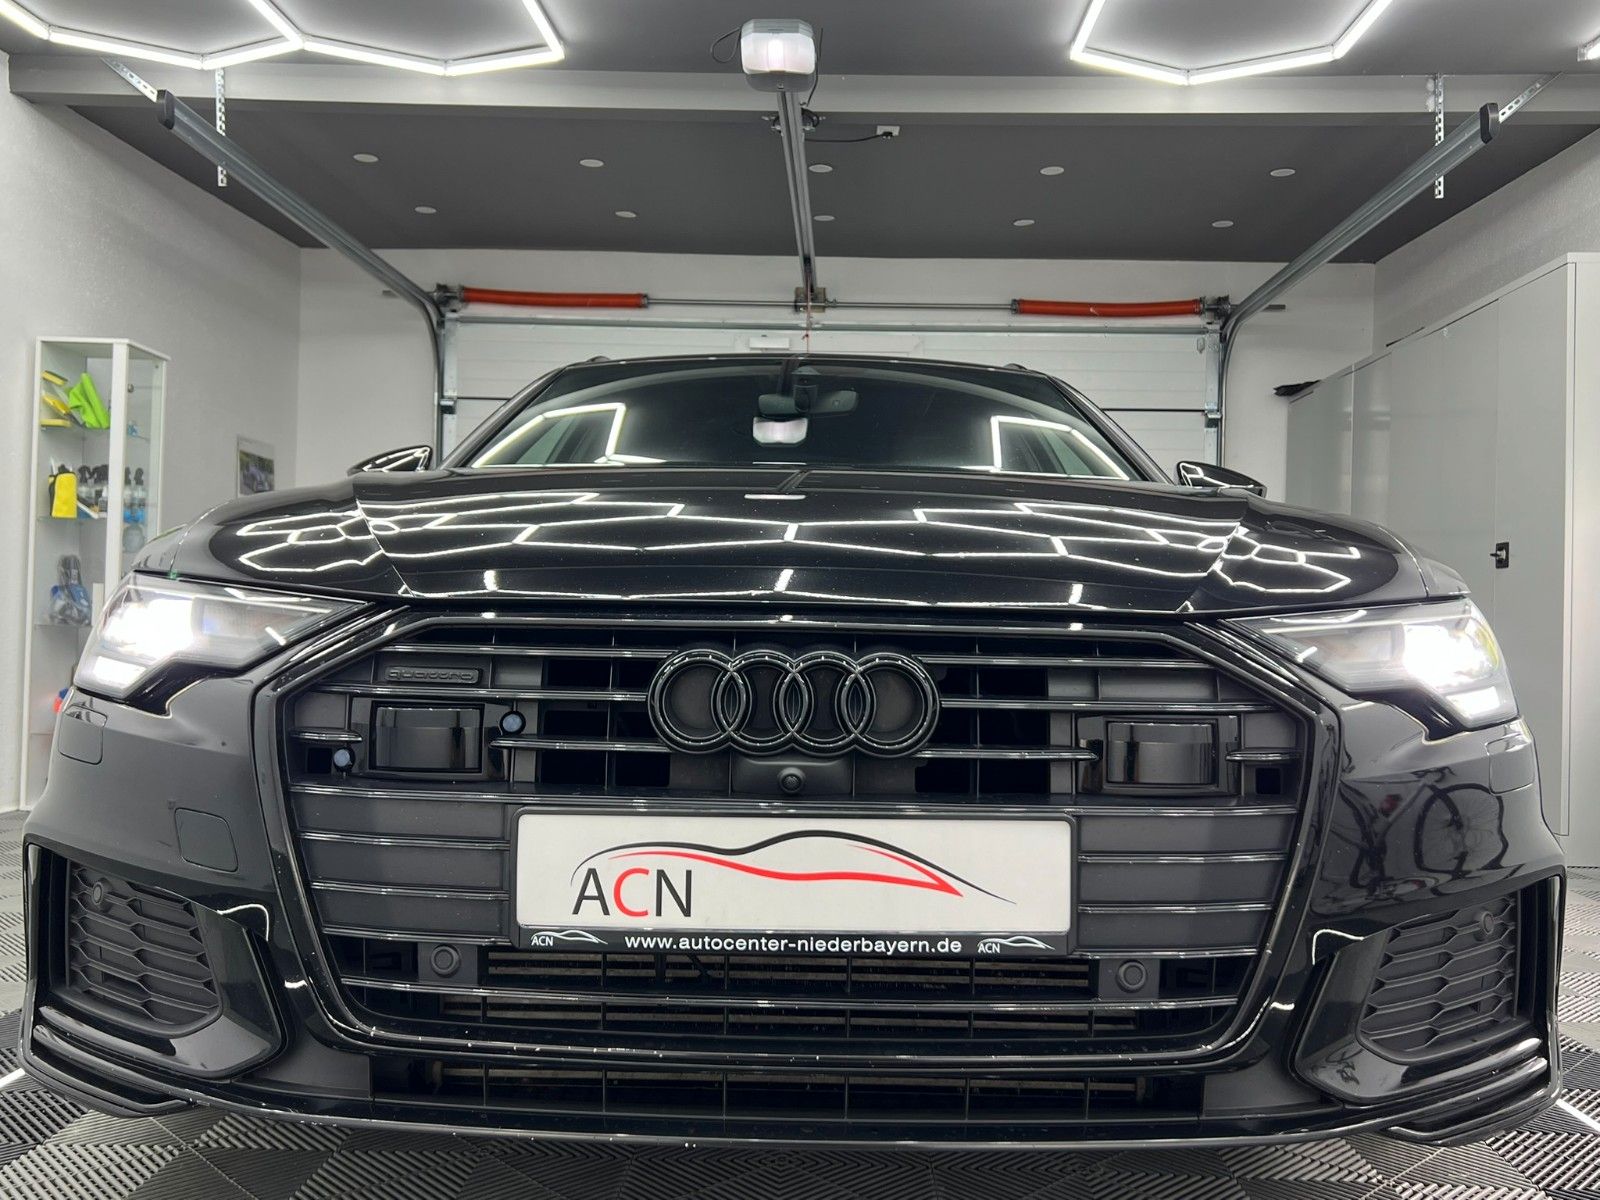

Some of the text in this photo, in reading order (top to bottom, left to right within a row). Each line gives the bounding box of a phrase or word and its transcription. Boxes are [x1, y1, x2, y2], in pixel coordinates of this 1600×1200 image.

[572, 867, 692, 917] ACN
[531, 936, 554, 947] ACN
[625, 935, 962, 955] www.autocenter-niederbayern.de
[977, 943, 1001, 954] ACN
